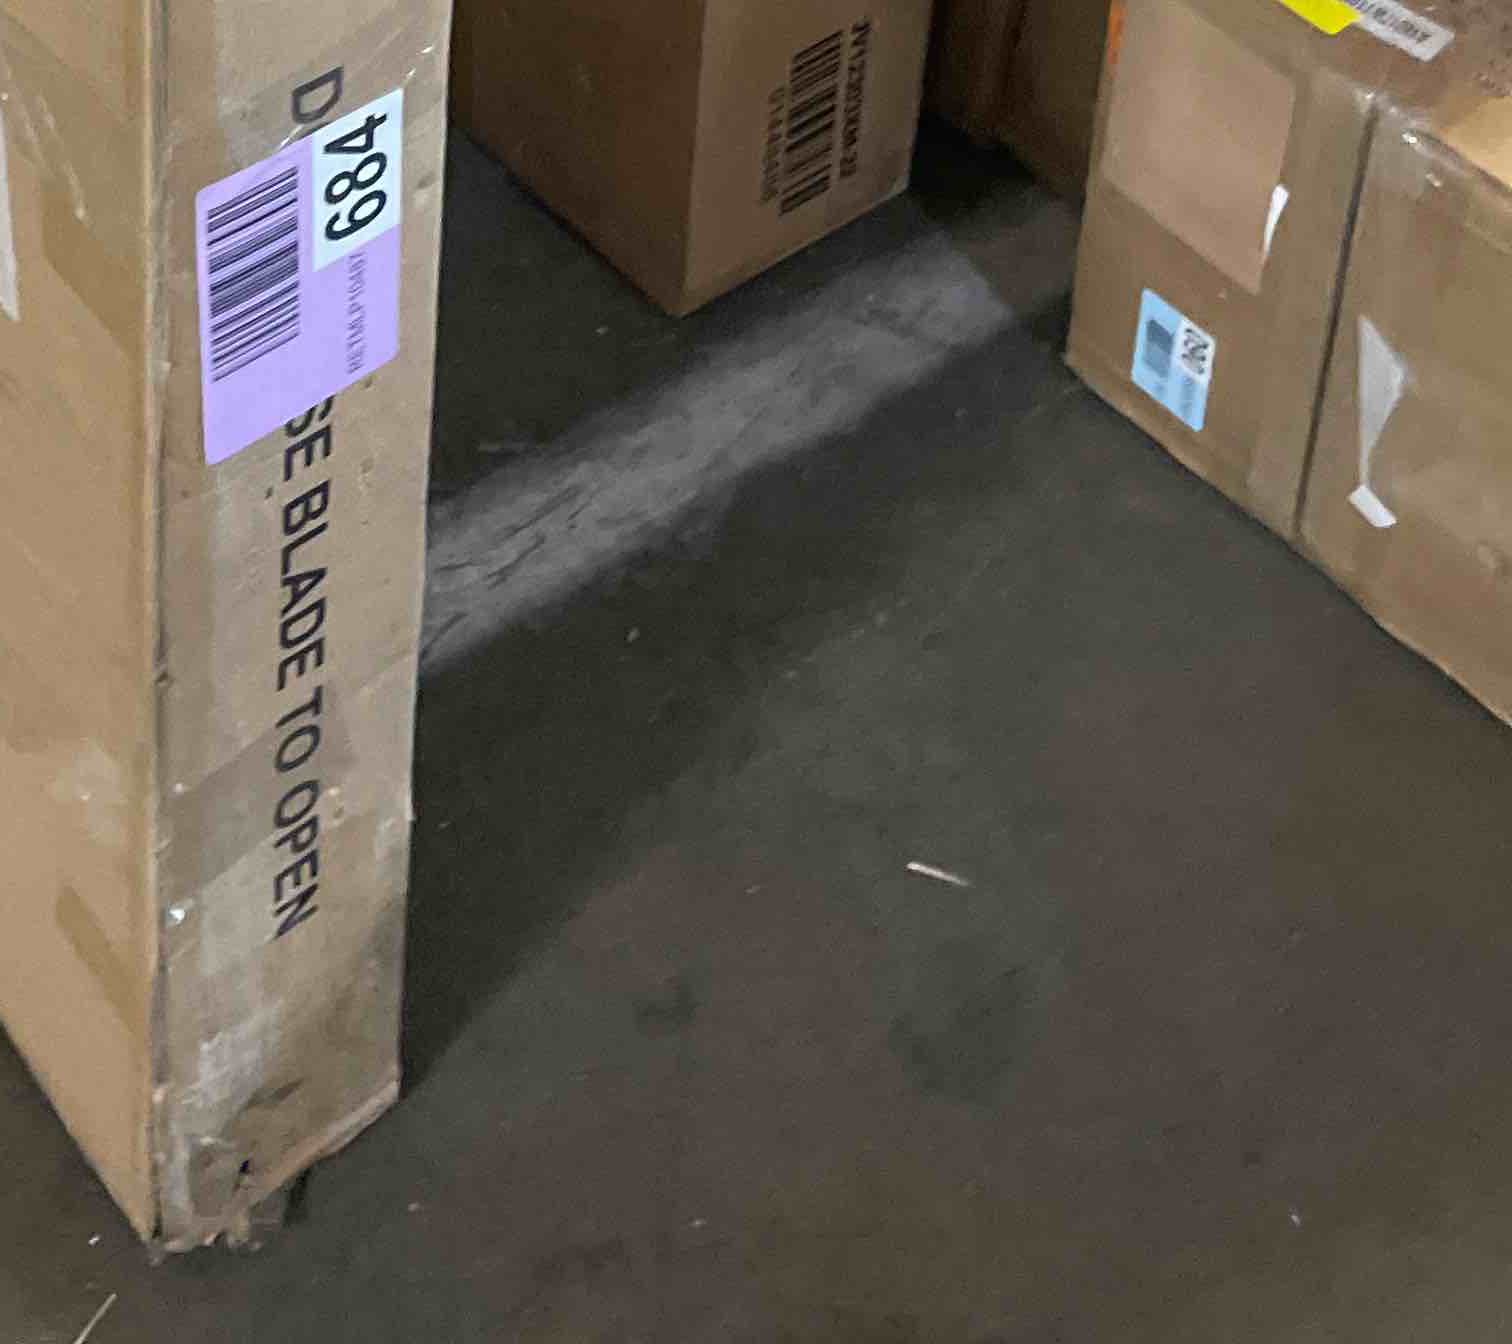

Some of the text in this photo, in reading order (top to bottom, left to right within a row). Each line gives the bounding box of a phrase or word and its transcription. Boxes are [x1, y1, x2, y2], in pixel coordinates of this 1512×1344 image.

[323, 111, 388, 241] 684
[271, 65, 343, 941] D SE BLADE TO OPEN
